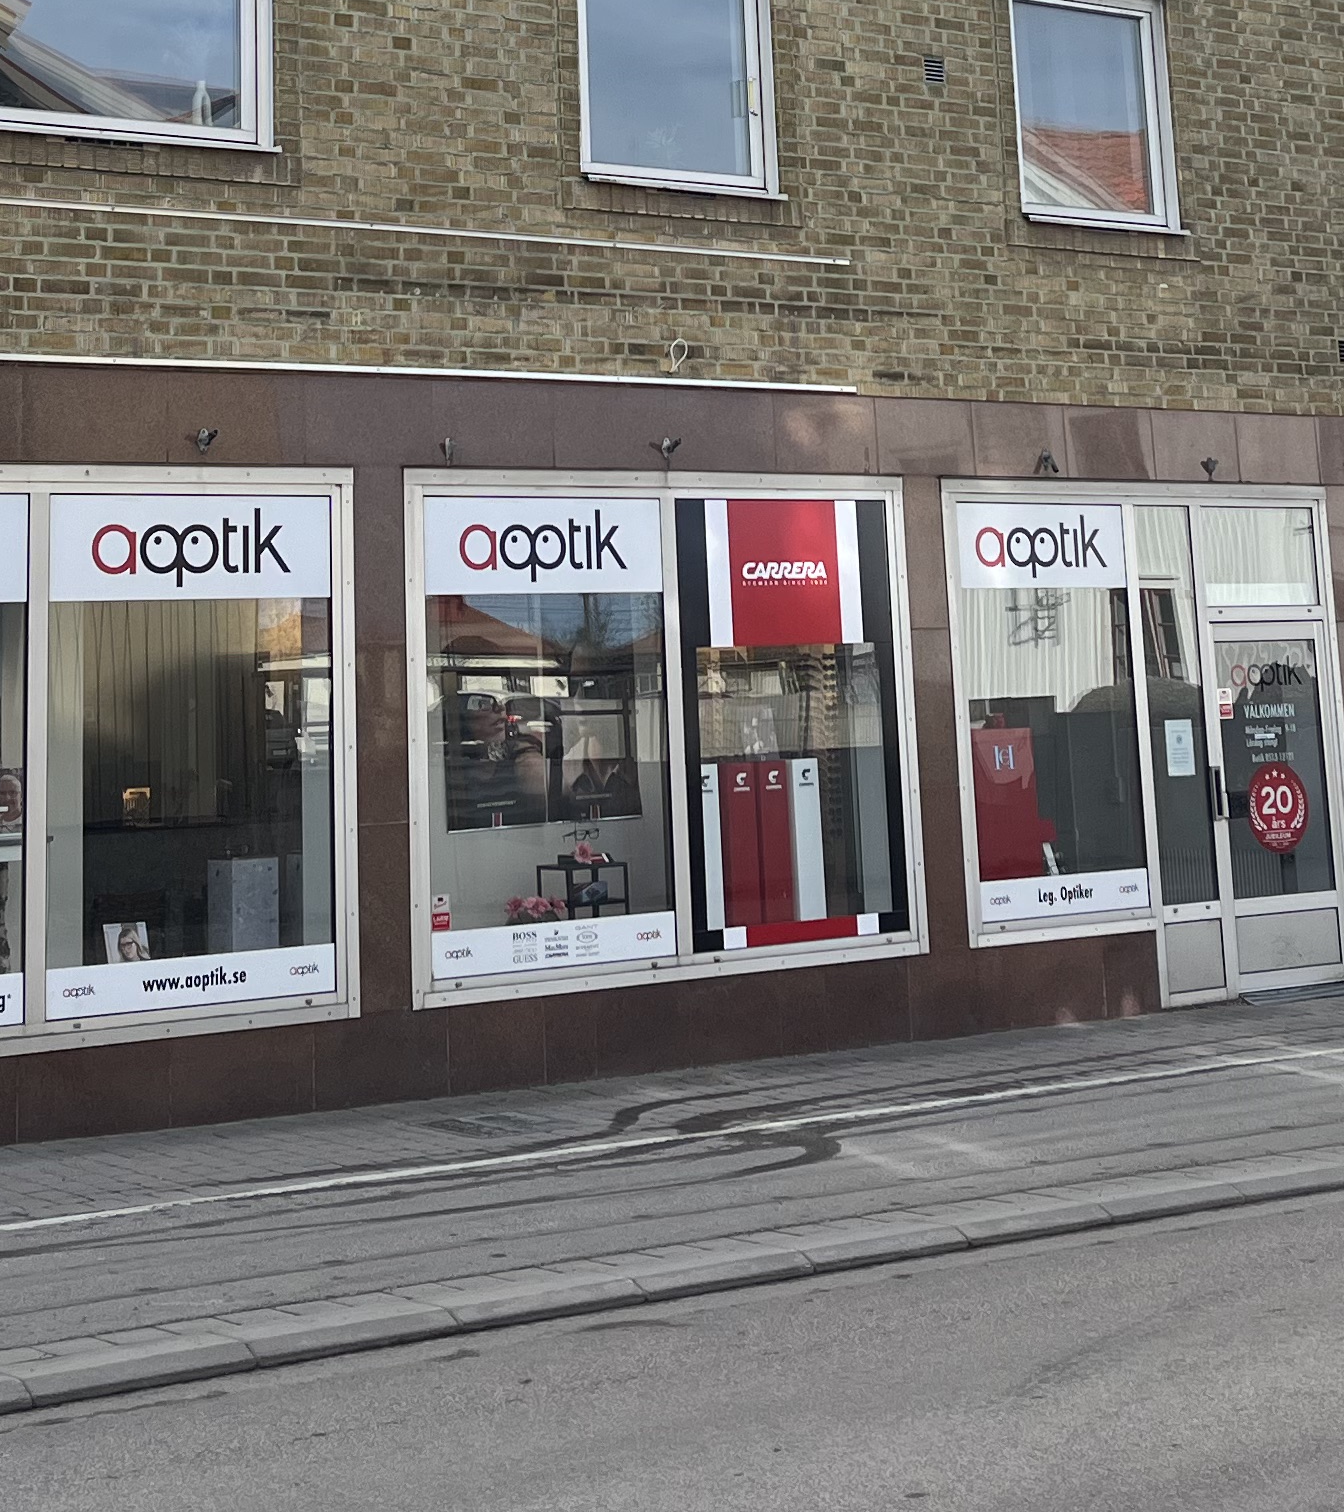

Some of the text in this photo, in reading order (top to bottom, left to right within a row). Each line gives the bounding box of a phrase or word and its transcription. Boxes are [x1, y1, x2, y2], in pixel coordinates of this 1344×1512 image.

[92, 507, 292, 588] aoptik
[459, 508, 628, 583] aoptik
[975, 514, 1108, 579] aoptik
[742, 561, 827, 579] CARRERA
[1231, 655, 1302, 692] aoptik
[1243, 701, 1295, 718] VÄLKOMMEN
[1261, 785, 1293, 815] 20
[1271, 816, 1286, 828] års
[1038, 883, 1093, 906] Leg. Optiker
[512, 931, 537, 941] BOSS
[444, 946, 473, 961] aoptik
[512, 953, 538, 964] GUESS
[289, 962, 320, 977] aoptik
[142, 966, 247, 997] www.aoptik.se
[62, 984, 95, 999] aoptik
